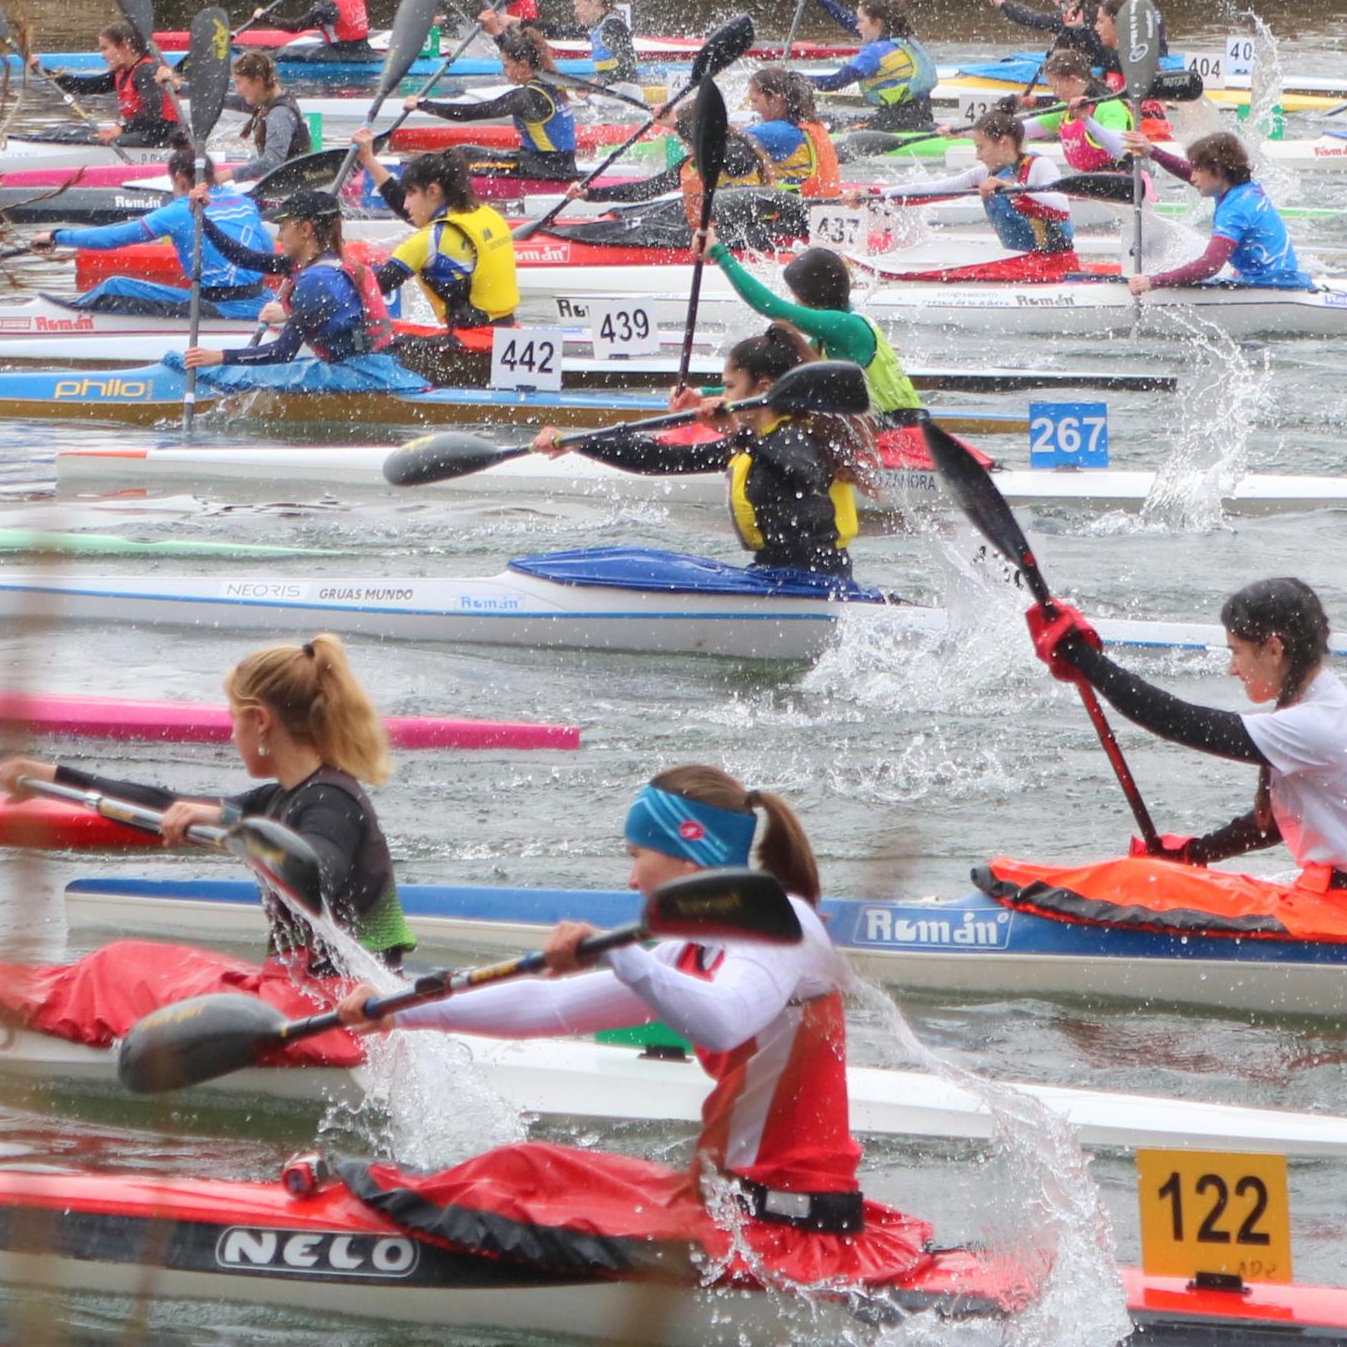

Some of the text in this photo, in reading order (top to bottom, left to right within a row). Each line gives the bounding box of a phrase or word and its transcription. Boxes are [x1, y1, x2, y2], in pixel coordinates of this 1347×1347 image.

[1189, 57, 1221, 78] 404
[817, 216, 860, 244] 437
[514, 245, 565, 261] omán
[1016, 294, 1074, 307] Román
[34, 313, 94, 330] Román
[601, 308, 650, 343] 439
[500, 339, 555, 374] 442
[54, 378, 145, 399] philo
[1031, 416, 1106, 454] 267
[226, 583, 302, 598] NEORIS
[318, 588, 414, 601] GRUAS MUNDO
[460, 595, 520, 610] Román
[865, 908, 999, 945] Román
[1158, 1171, 1271, 1246] 122
[224, 1230, 414, 1272] NELO
